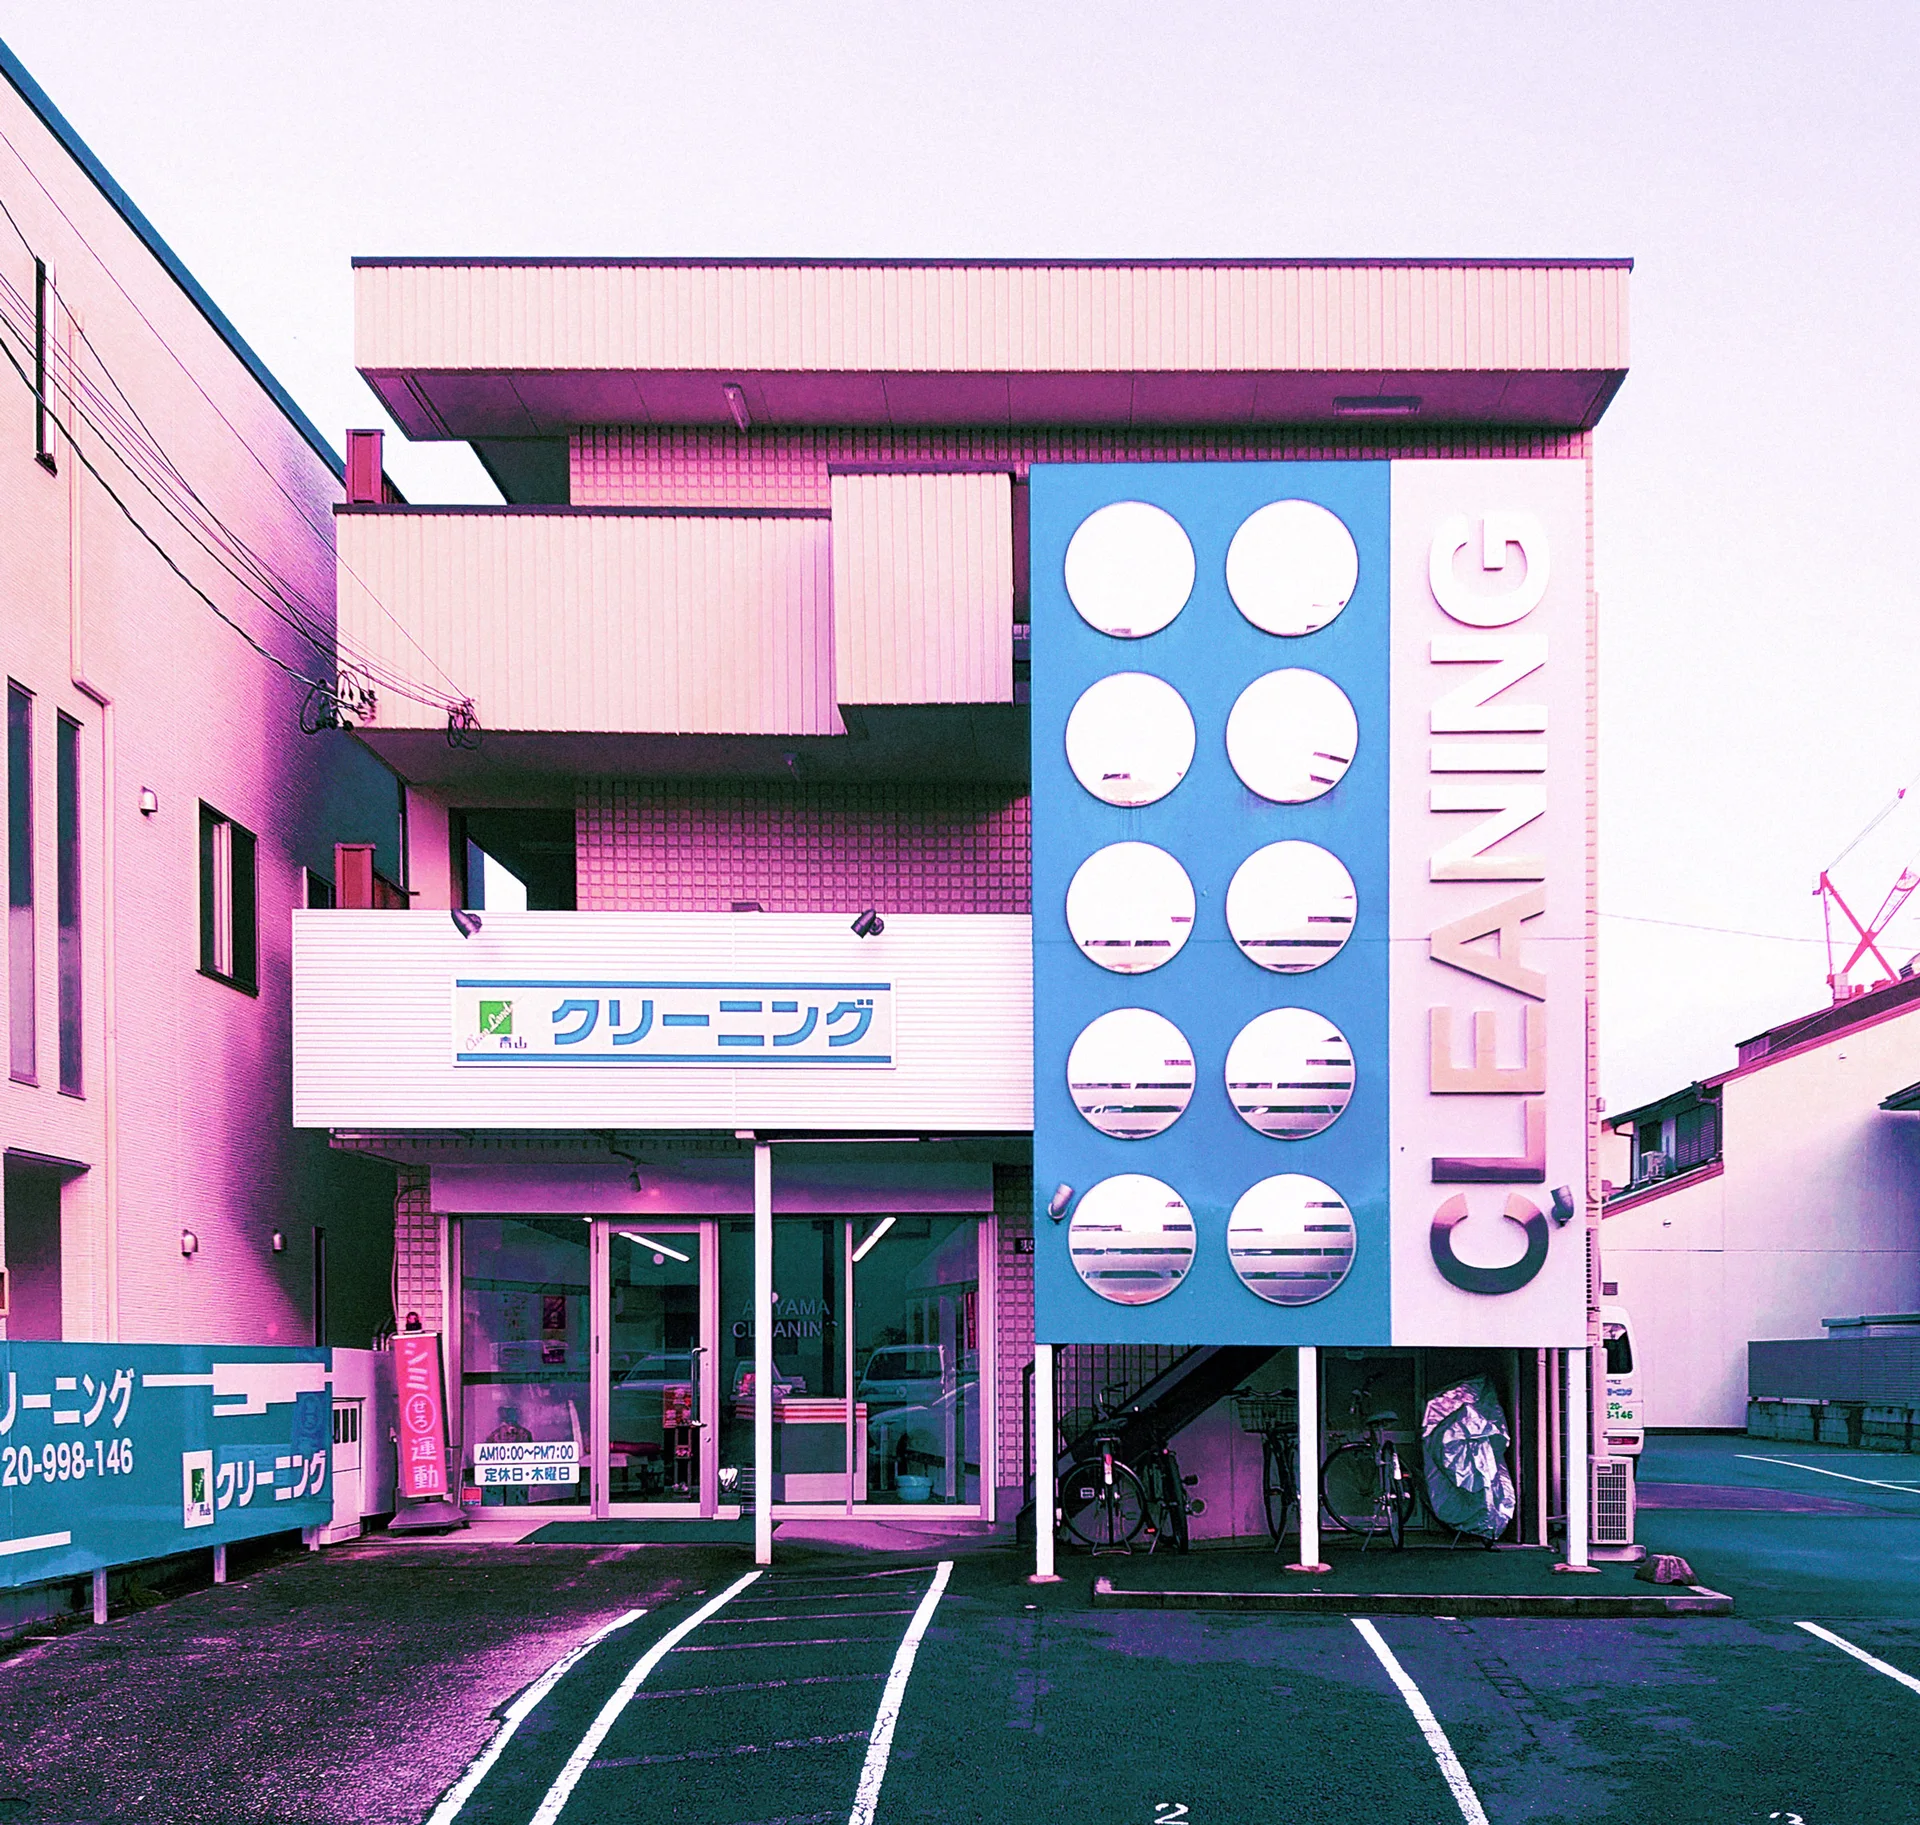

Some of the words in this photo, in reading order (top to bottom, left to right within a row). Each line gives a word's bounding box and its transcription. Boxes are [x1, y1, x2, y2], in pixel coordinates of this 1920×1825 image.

[1428, 509, 1549, 1295] CLEANING
[552, 999, 874, 1047] クリーニング
[742, 1299, 831, 1316] AYAMA
[732, 1321, 838, 1338] CLANIN
[2, 1437, 134, 1487] 20-998-146
[485, 1466, 570, 1482] 定休日・木曜日
[216, 1450, 326, 1511] クリーニング
[1154, 1802, 1189, 1825] 2
